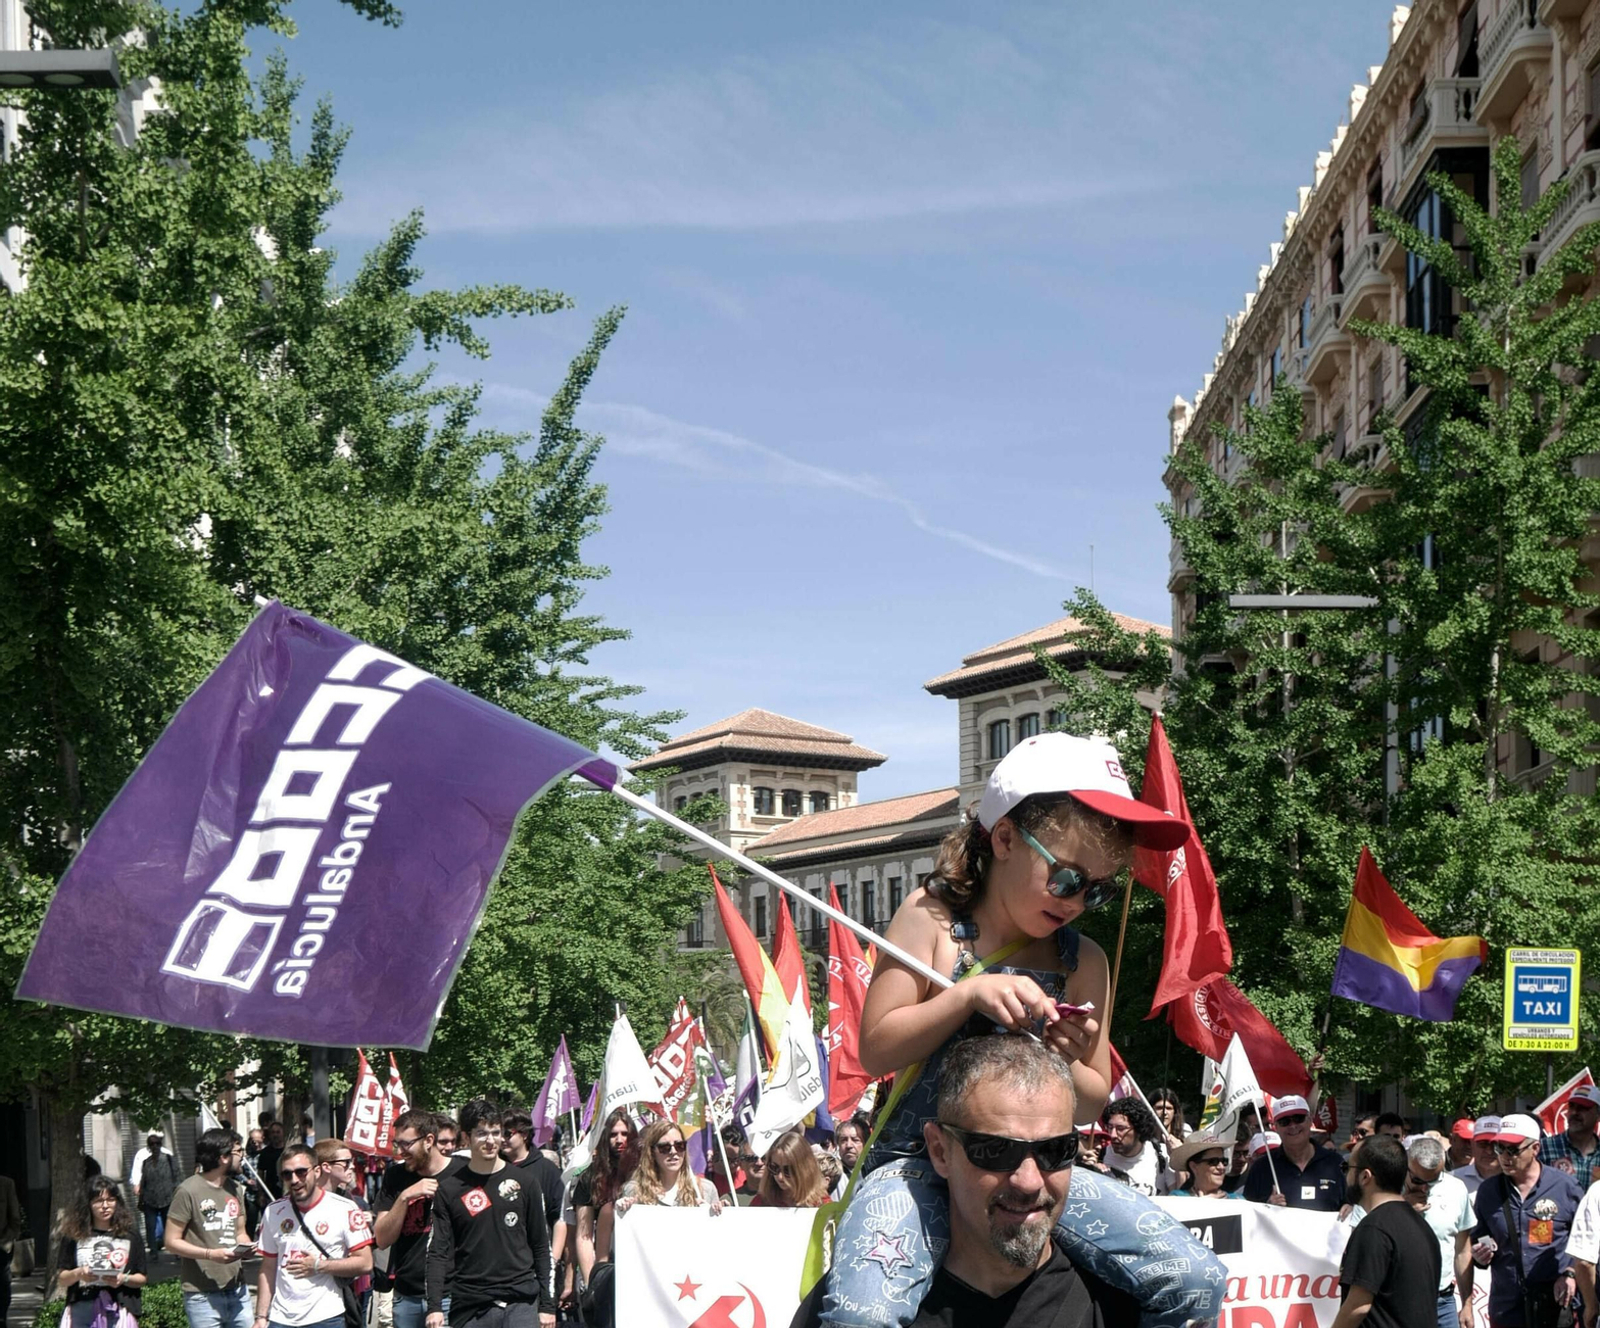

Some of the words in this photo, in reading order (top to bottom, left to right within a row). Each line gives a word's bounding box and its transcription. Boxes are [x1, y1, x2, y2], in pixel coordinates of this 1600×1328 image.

[1523, 1001, 1562, 1015] TAXI
[1508, 1040, 1517, 1048] DE
[1319, 1102, 1333, 1127] SOE
[1259, 1272, 1341, 1299] una
